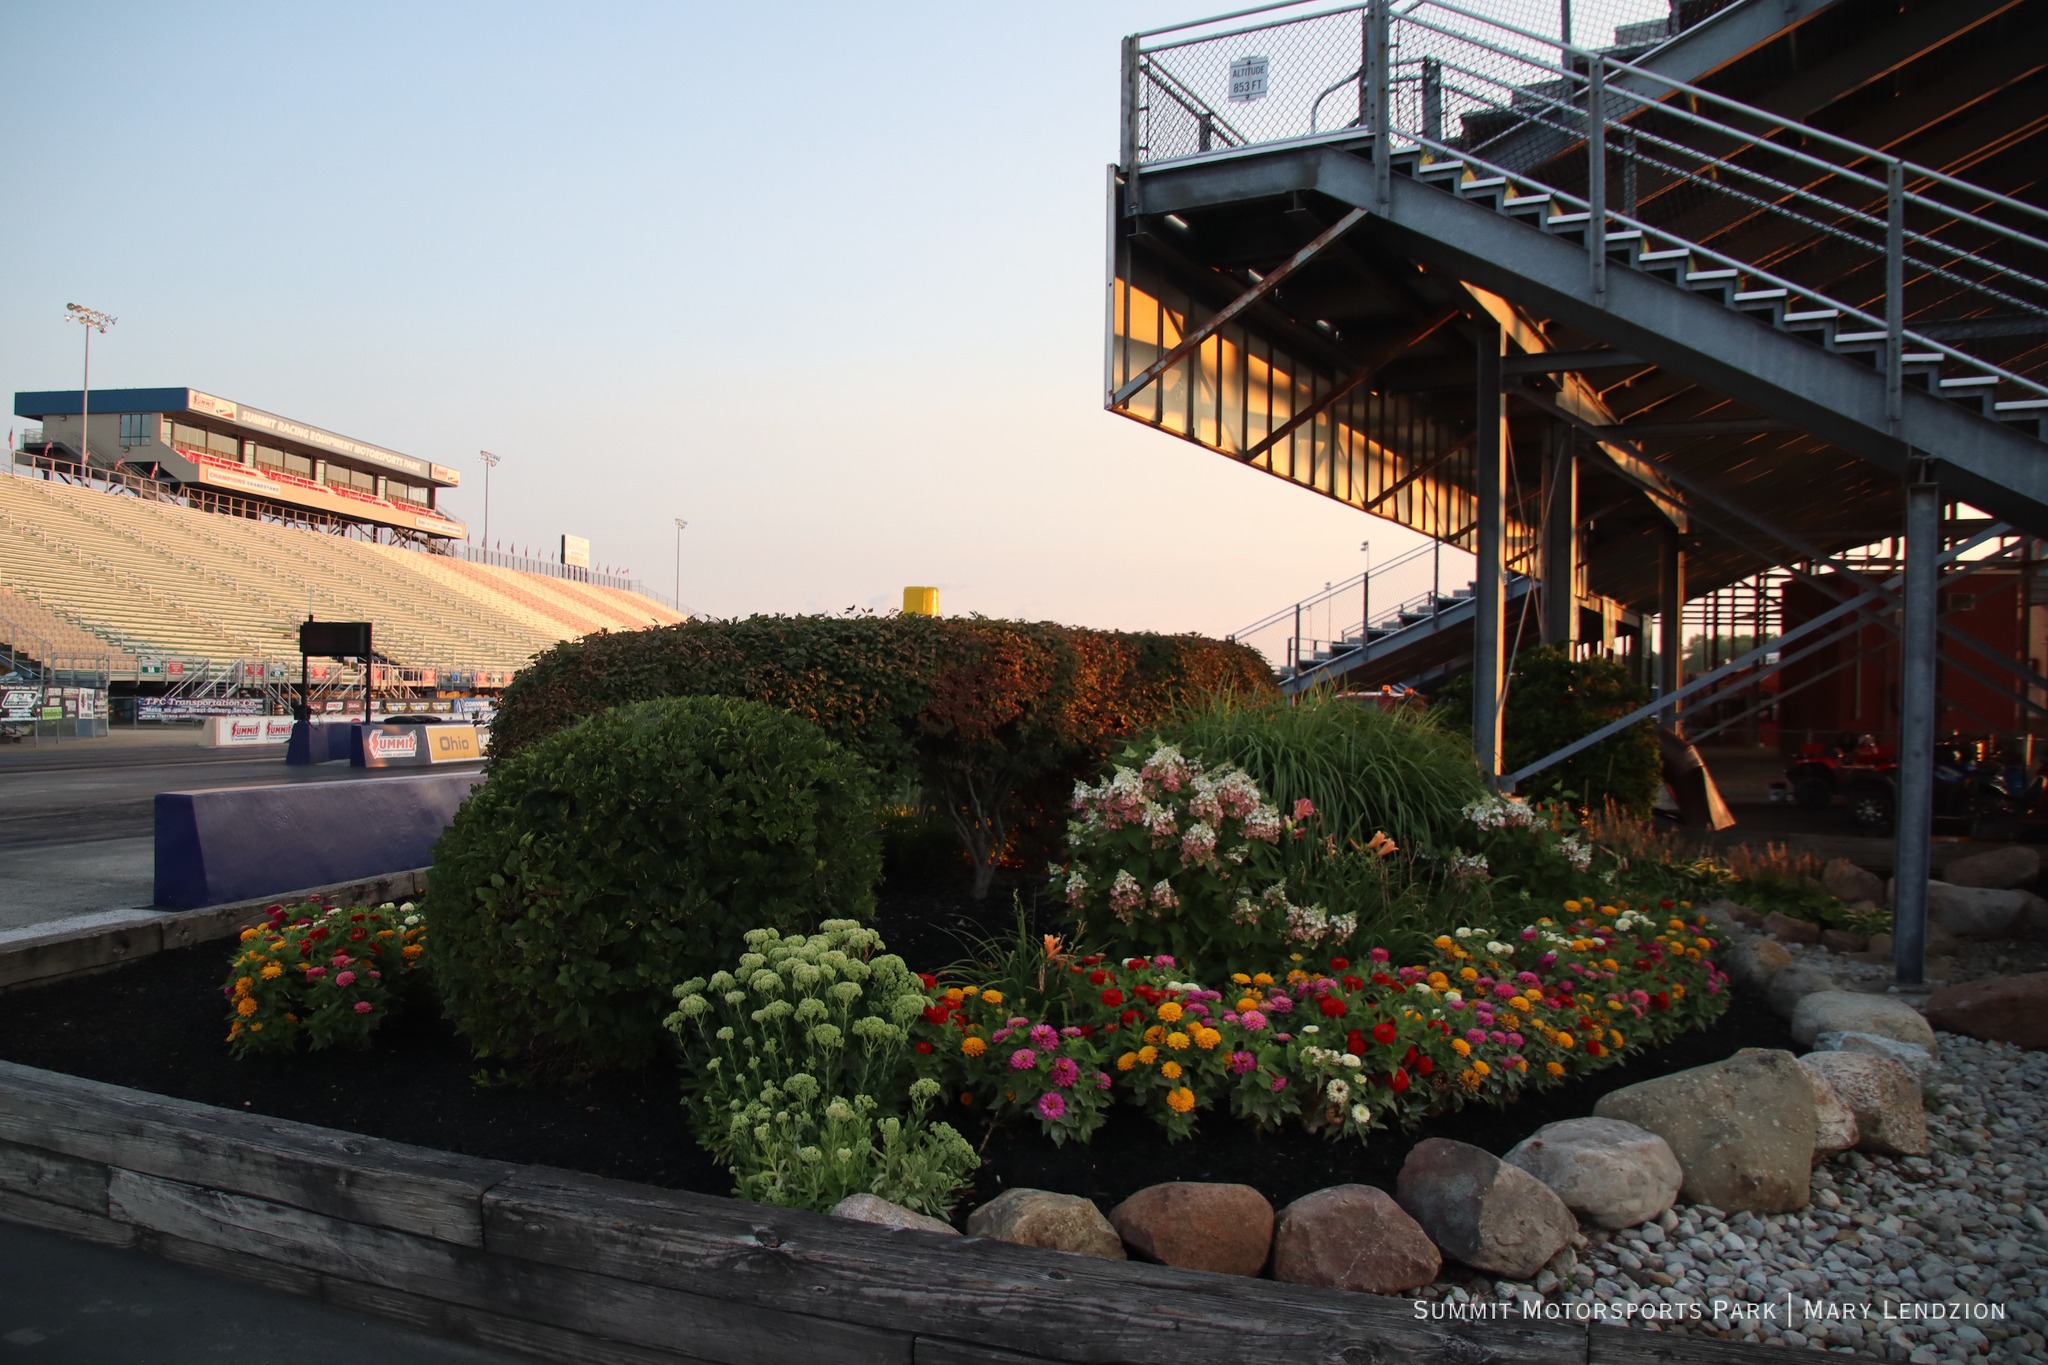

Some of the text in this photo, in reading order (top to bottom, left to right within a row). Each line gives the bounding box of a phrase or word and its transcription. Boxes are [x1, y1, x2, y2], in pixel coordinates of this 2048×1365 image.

[1232, 66, 1265, 78] ALTITUDE
[1233, 79, 1262, 94] 853 FT
[241, 411, 421, 472] SUMMIT RACING EQUIPMENT MOTORSPORTS PARK
[209, 471, 245, 485] CHAMPIONS
[167, 697, 240, 708] Transportation
[243, 699, 257, 707] Co.
[231, 722, 259, 737] SUMMIT
[266, 722, 292, 737] SUMMIT
[371, 732, 414, 752] SUMMIT
[440, 736, 469, 751] Ohio
